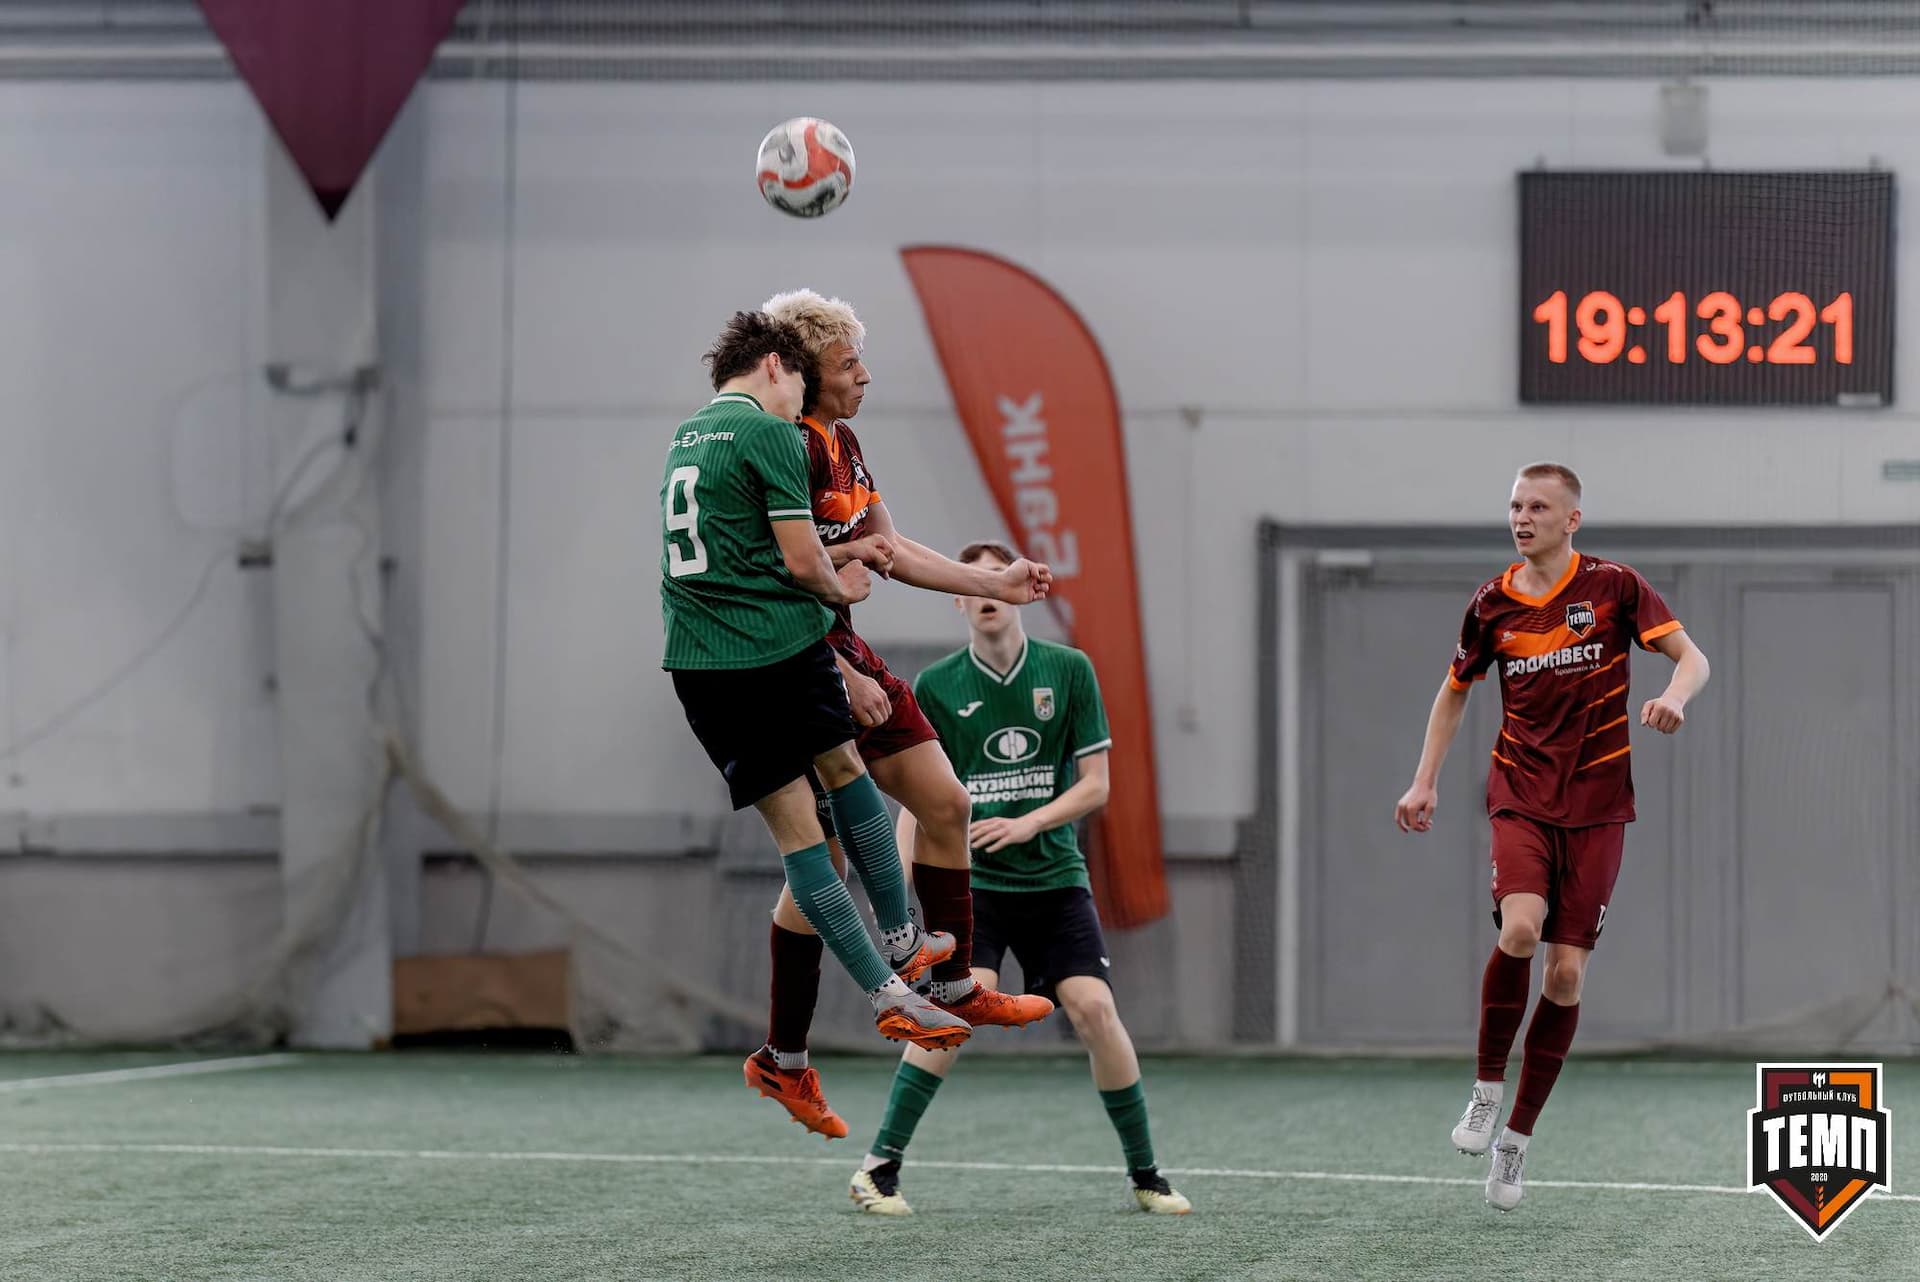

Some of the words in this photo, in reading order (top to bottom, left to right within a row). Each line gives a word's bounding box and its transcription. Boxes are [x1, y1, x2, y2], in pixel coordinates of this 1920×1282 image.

[1533, 290, 1854, 364] 19:13:21
[666, 465, 708, 577] 9
[1506, 643, 1603, 677] РОДИНВЕСТ
